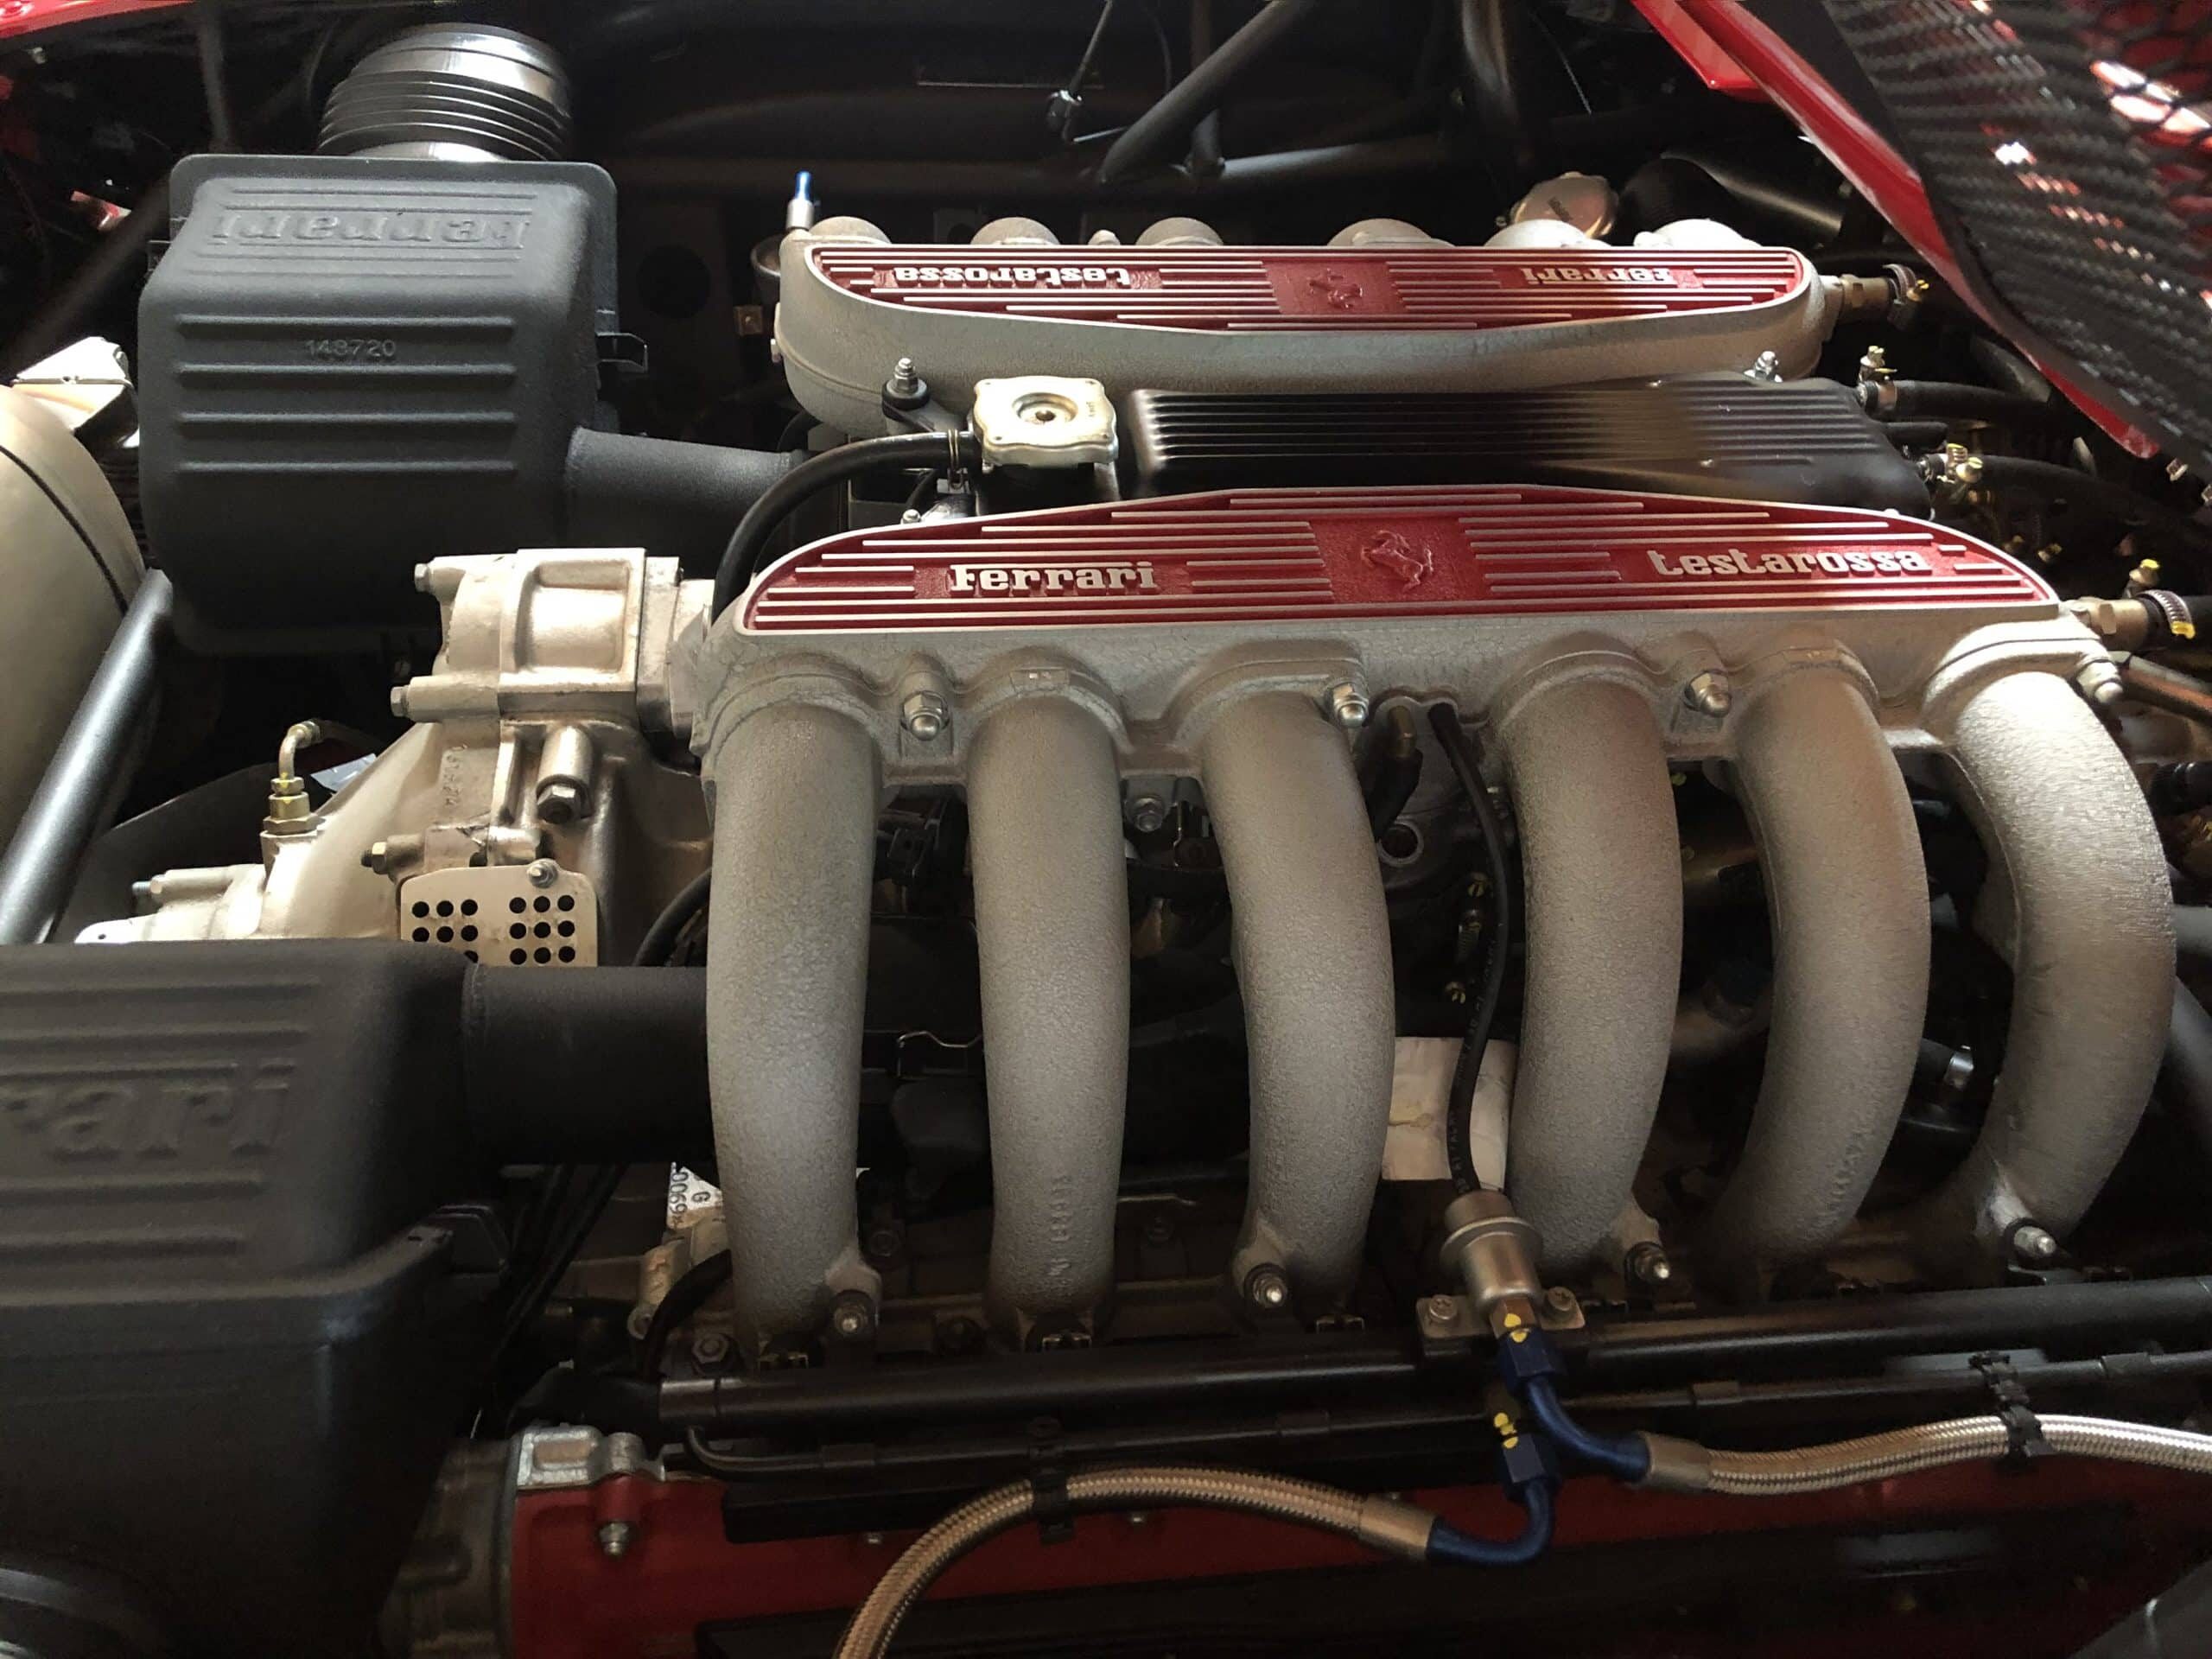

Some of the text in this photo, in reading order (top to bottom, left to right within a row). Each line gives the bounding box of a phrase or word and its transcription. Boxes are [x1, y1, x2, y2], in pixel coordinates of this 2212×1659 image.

[208, 213, 530, 250] Ferrari
[893, 266, 1131, 287] testarossa
[949, 548, 1934, 592] Ferrari testarossa
